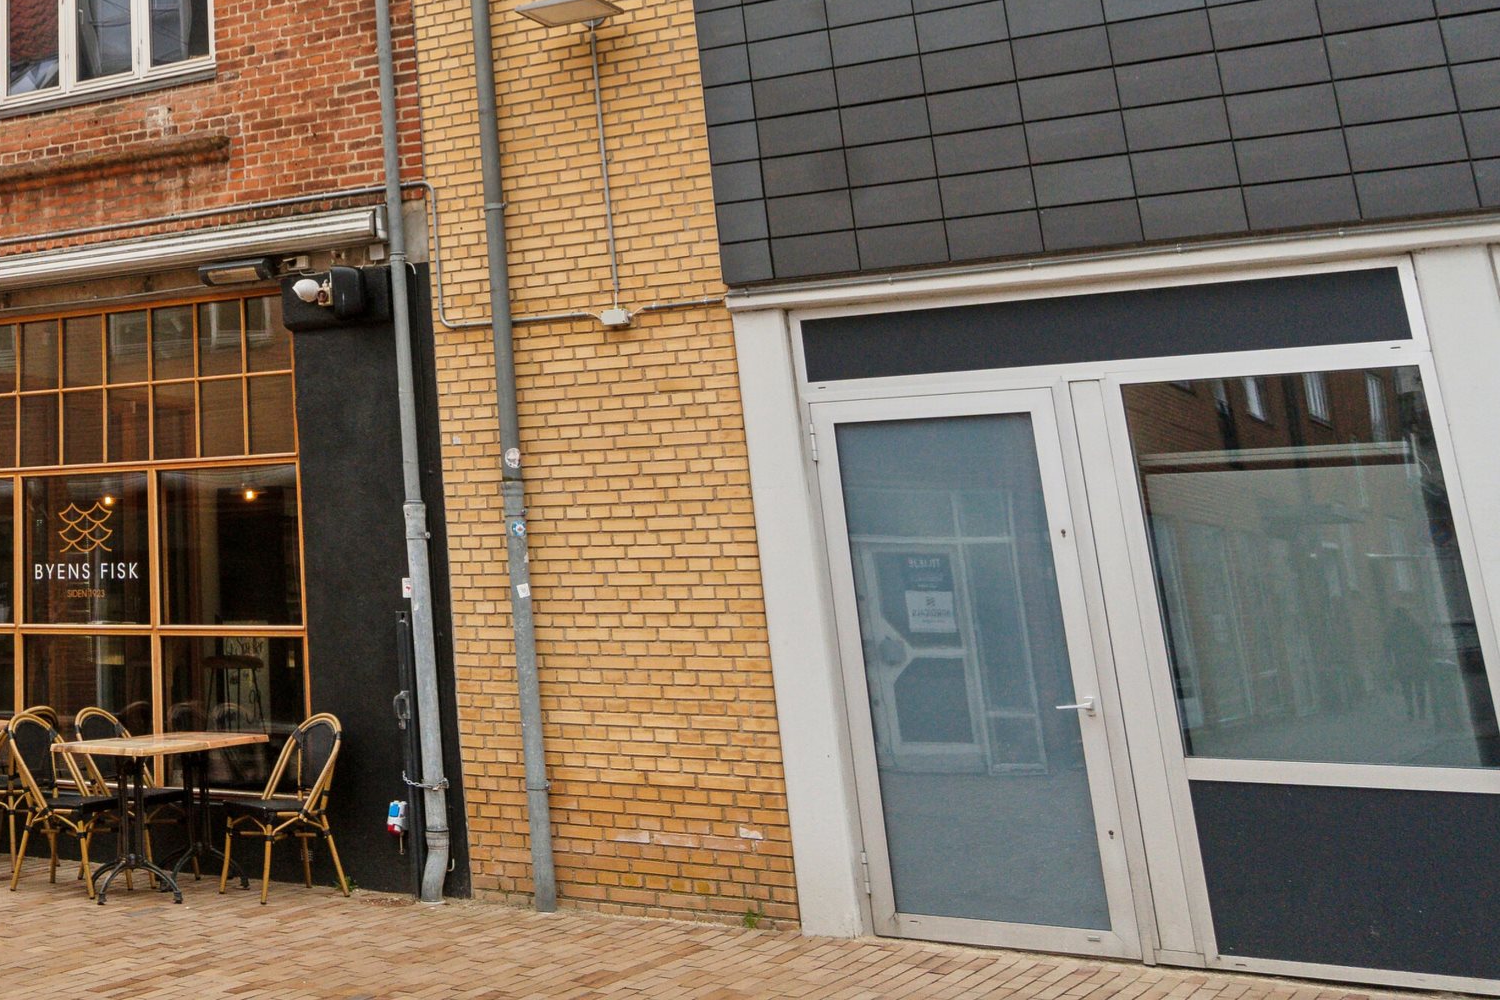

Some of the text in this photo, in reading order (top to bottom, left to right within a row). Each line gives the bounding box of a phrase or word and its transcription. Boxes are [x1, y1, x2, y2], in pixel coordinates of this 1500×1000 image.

[34, 562, 139, 580] BYENS FISK
[67, 589, 87, 598] SIDEN
